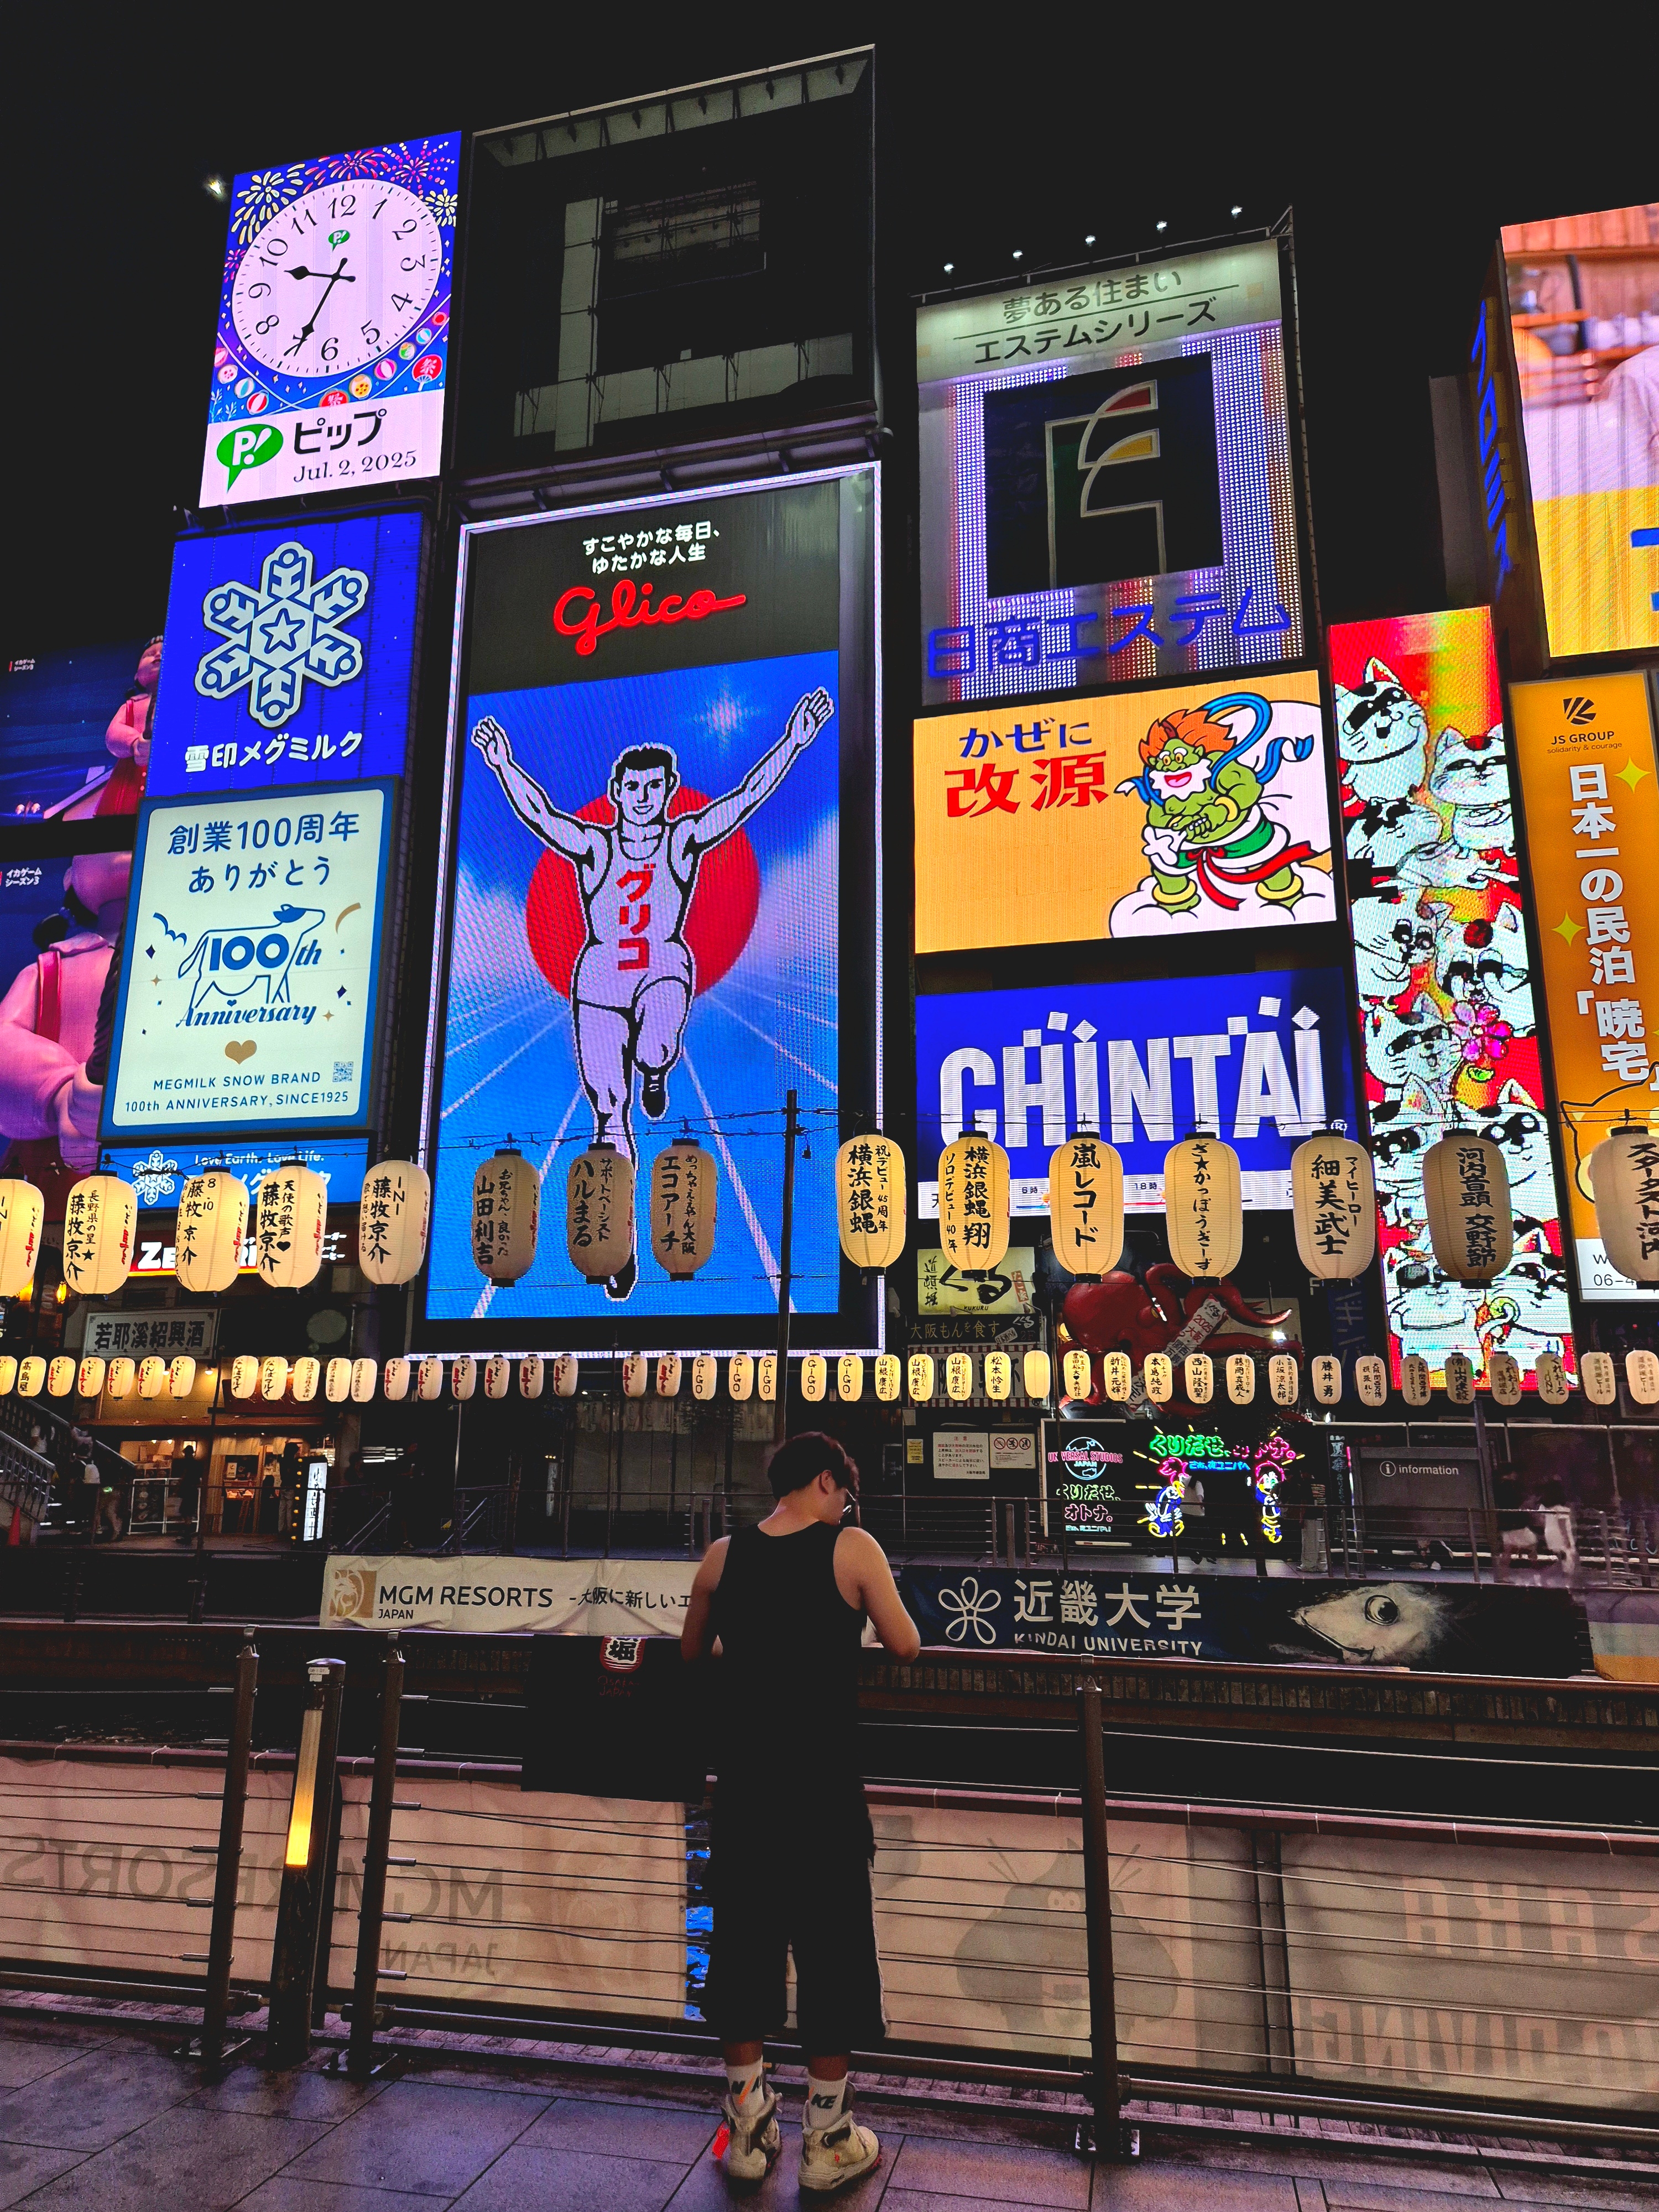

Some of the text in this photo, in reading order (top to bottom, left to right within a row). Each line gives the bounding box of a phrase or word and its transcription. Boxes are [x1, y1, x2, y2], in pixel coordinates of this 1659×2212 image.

[290, 209, 318, 236] 11
[328, 195, 356, 218] 12
[371, 198, 388, 220] 1
[392, 218, 417, 241] 2
[259, 238, 289, 268] 10
[400, 254, 427, 272] 3
[248, 283, 271, 301] 9
[390, 292, 414, 313] 4
[1003, 270, 1182, 323] 夢ある住まい
[255, 315, 280, 335] 8
[360, 320, 380, 345] 5
[974, 297, 1216, 365] エステムシリーズ
[320, 338, 338, 361] 6
[294, 409, 387, 455] ピップ
[294, 450, 417, 483] Jul. 2, 2025
[583, 520, 719, 555] すこやかな毎日、
[592, 542, 706, 575] ゆたかな人生
[927, 588, 1291, 679] 日商エステム
[185, 731, 362, 773] 雪印メグミルク
[959, 717, 1093, 758] かぜに
[1547, 744, 1582, 754] solidarity
[1591, 742, 1623, 750] courage
[1551, 731, 1615, 745] JS GROUP
[945, 750, 1108, 818] 改源
[168, 811, 359, 855] 創業100周年
[6, 876, 39, 886] シーズン3
[7, 868, 42, 877] イカゲーム
[189, 857, 330, 894] ありがとう
[616, 863, 656, 970] グリコ
[209, 933, 322, 971] 100th
[176, 1002, 316, 1027] Anniversary
[154, 1072, 320, 1091] MEGMILK SNOW BRAND
[125, 1100, 159, 1113] 100th
[298, 1151, 325, 1161] Life.
[1021, 1186, 1039, 1194] 6時
[1134, 1182, 1157, 1191] 18時
[1345, 1156, 1361, 1227] マイヒーロー
[1459, 1147, 1493, 1207] 河内音頭
[573, 1160, 595, 1247] ハルまる
[660, 1156, 681, 1252] エコアーチ
[1070, 1144, 1100, 1247] 嵐レコード
[1311, 1154, 1350, 1255] 細美武士
[182, 1180, 205, 1266] 藤牧京介
[259, 1182, 280, 1273] 藤牧京介
[367, 1176, 392, 1264] 藤牧京介
[475, 1176, 495, 1265] 山田利吉
[962, 1222, 991, 1249] 翔
[66, 1193, 85, 1281] 藤牧京介
[1465, 1213, 1497, 1267] 交野節
[924, 1255, 938, 1307] 道頓堀
[911, 1320, 999, 1339] 大阪もんを食す
[1013, 1316, 1034, 1328] くくる
[1185, 1326, 1204, 1343] 大阪
[1193, 1314, 1213, 1333] 2025
[878, 1359, 888, 1394] 山根康広
[911, 1359, 921, 1395] 山根康広
[951, 1359, 961, 1394] 山根康広
[990, 1356, 1003, 1394] 松本怜生
[1110, 1357, 1121, 1394] 新井元輝
[1150, 1357, 1162, 1395] 本島純政
[1275, 1360, 1286, 1399] 小坂涼太郎
[1048, 1451, 1123, 1463] UNVERSAL STUDIOS
[1399, 1464, 1459, 1477] information
[1065, 1504, 1113, 1522] オトナ。
[379, 1585, 552, 1608] MGM RESORTS
[1014, 1578, 1202, 1631] 近畿大学
[378, 1609, 414, 1619] JAPAN
[1014, 1632, 1203, 1656] KINDAI UNIVERSITY
